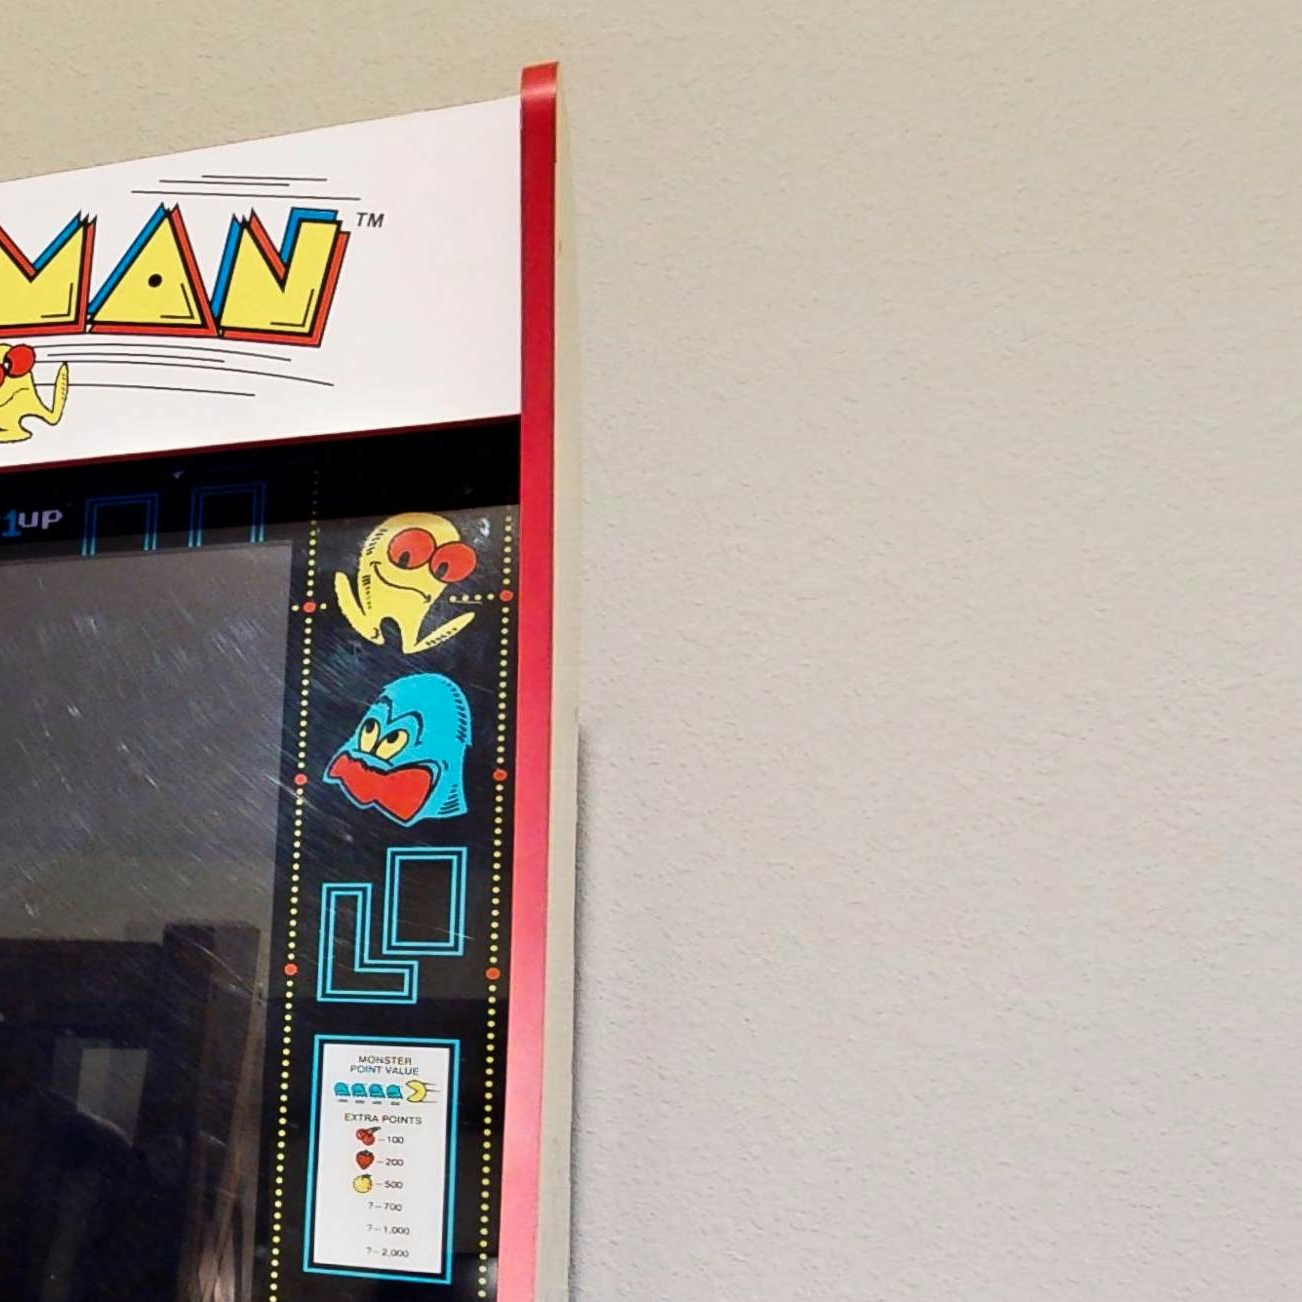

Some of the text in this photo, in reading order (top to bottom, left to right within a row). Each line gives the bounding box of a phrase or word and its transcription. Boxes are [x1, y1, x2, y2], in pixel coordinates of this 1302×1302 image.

[358, 1055, 412, 1066] MONSTER
[350, 1064, 419, 1076] POINT VALUE
[344, 1112, 422, 1125] EXTRA POINTS
